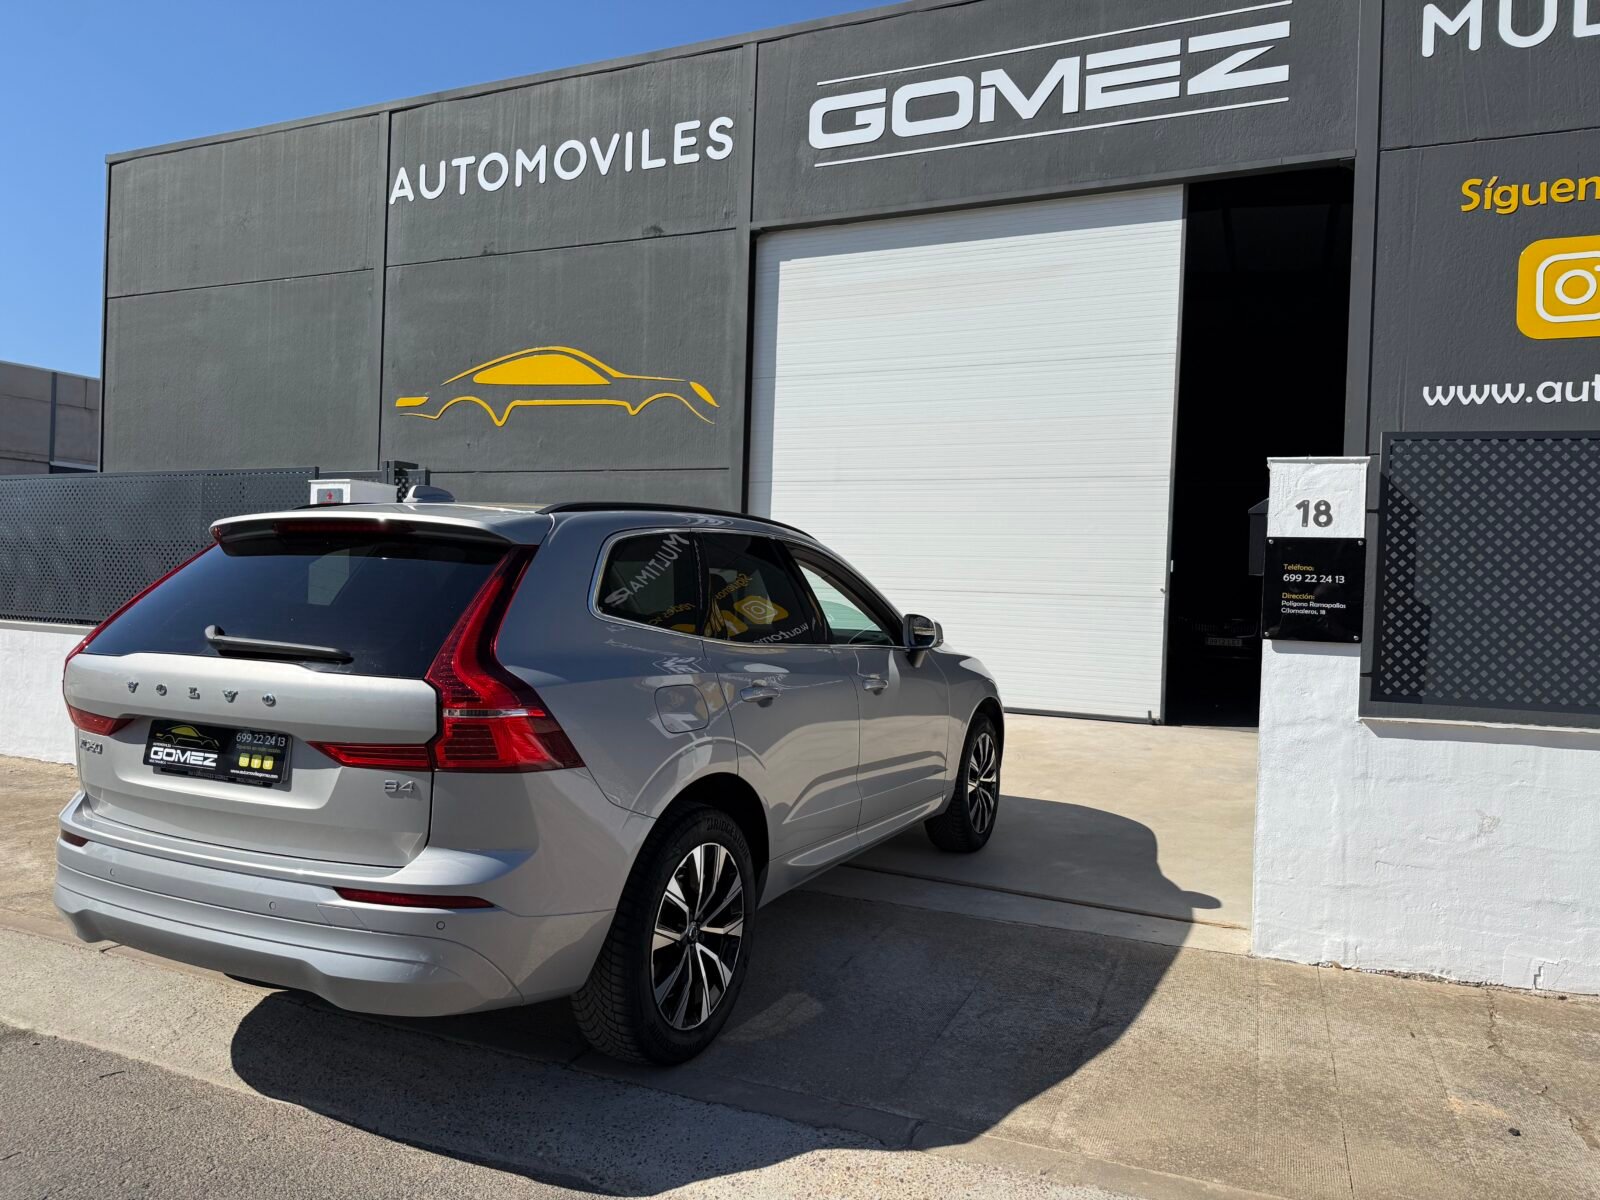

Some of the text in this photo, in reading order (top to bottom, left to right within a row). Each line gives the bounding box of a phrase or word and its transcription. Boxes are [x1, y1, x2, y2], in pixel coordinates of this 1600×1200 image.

[808, 20, 1290, 150] GOMEZ
[389, 116, 734, 205] AUTOMOVILES
[1295, 499, 1333, 528] 18
[1283, 563, 1315, 571] Teléfono:
[1283, 573, 1345, 584] 699 22 24 13
[1281, 592, 1315, 600] Dirección:
[1281, 600, 1308, 608] Polígono
[127, 681, 277, 708] VOLVO
[236, 732, 286, 747] 699 22 24 13
[150, 746, 218, 767] GOMEZ
[385, 780, 414, 793] B4
